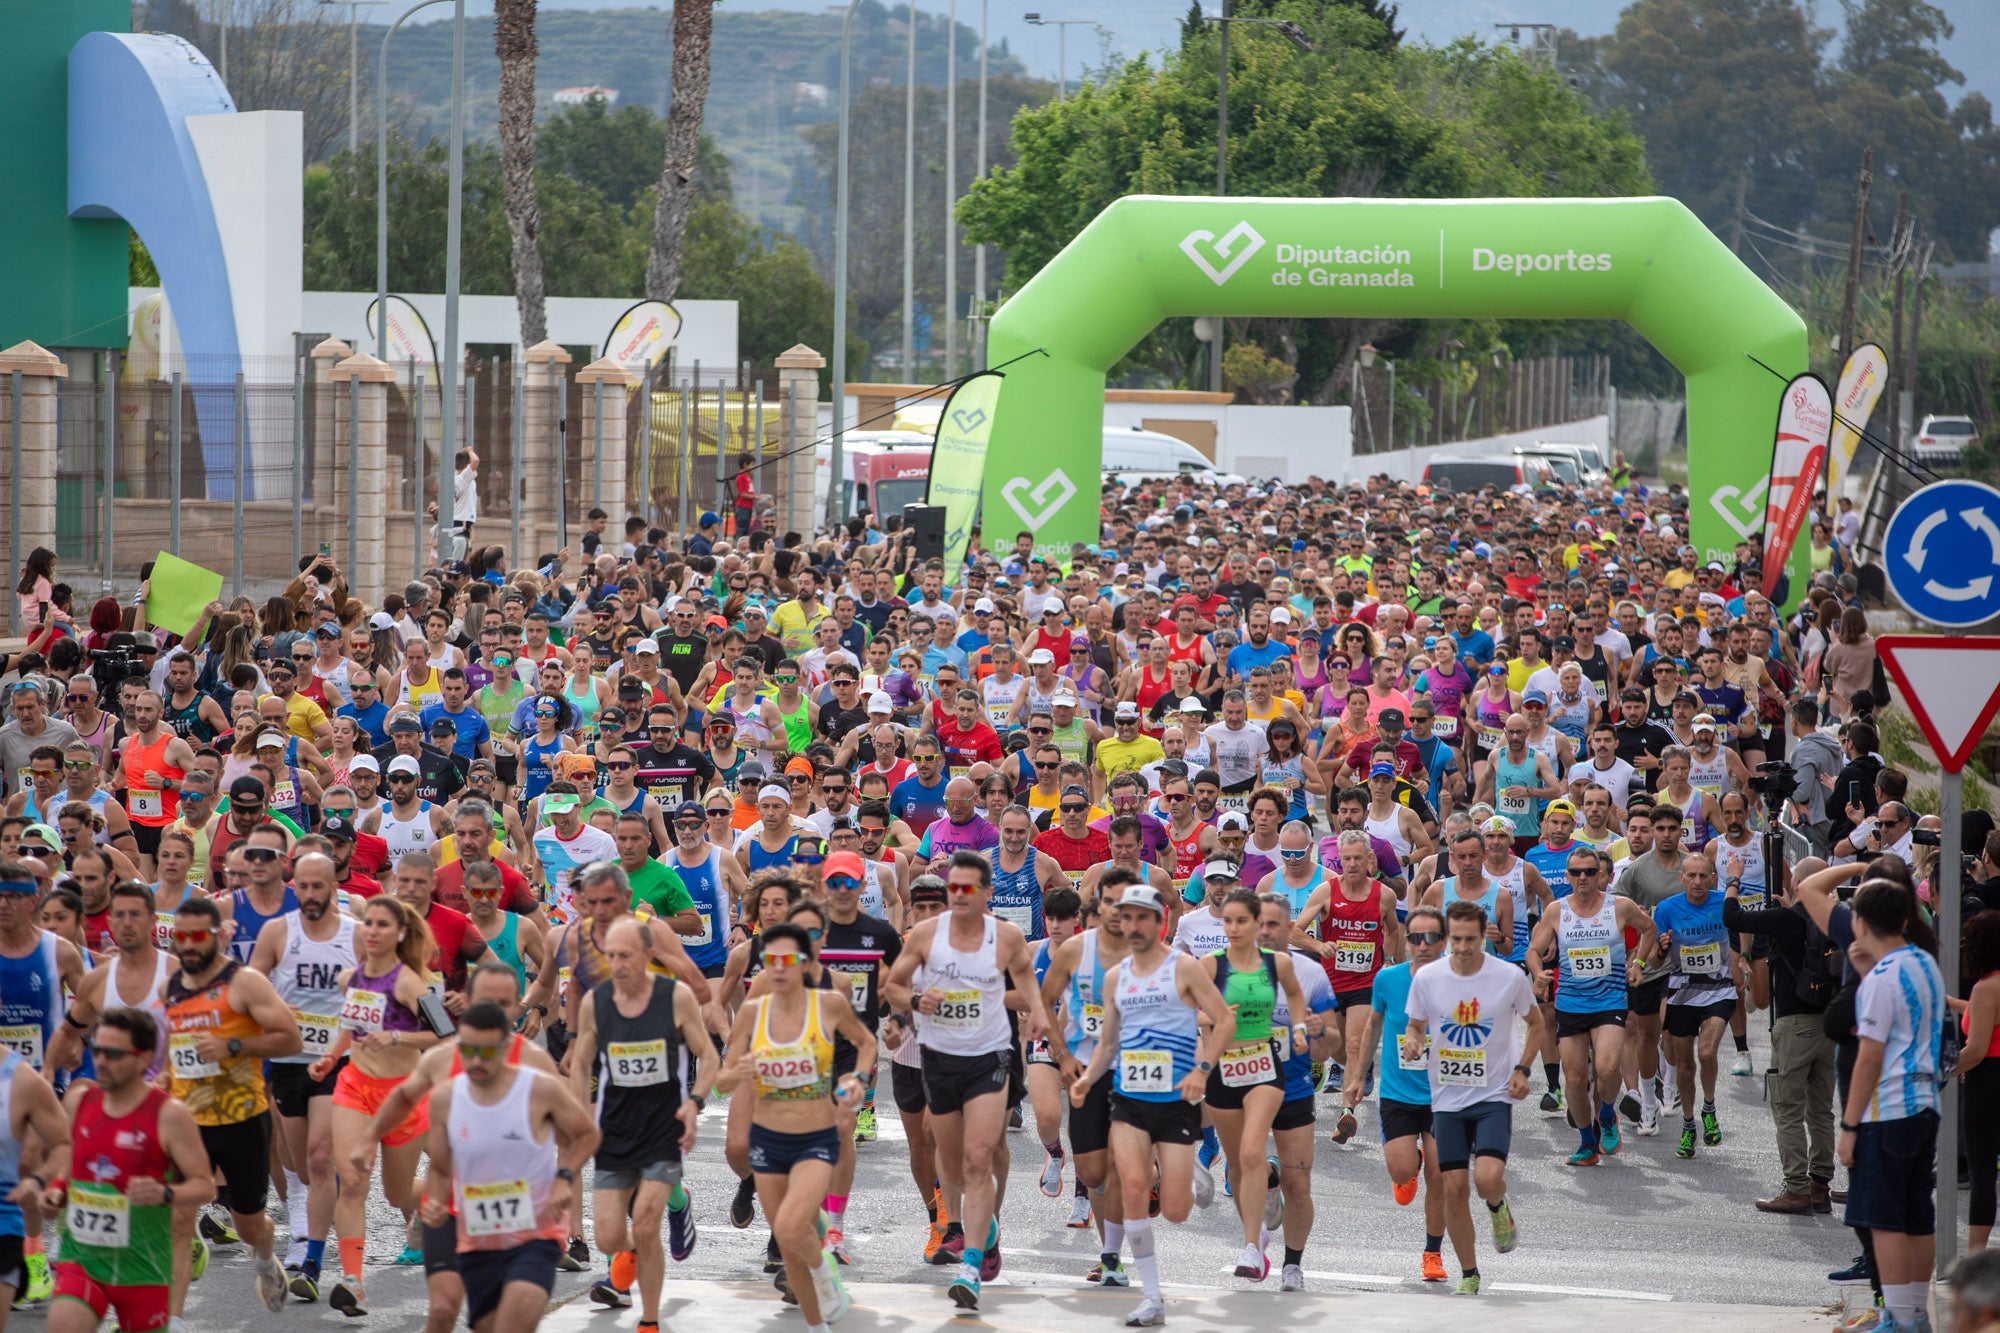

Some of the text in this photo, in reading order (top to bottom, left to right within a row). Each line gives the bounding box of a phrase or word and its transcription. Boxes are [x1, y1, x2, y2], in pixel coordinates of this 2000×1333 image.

[1275, 243, 1411, 268] Diputación
[1471, 248, 1613, 276] Deportes
[1271, 268, 1415, 288] de Granada
[934, 483, 981, 498] Deportes
[139, 799, 147, 810] 8
[269, 790, 295, 803] 032
[1503, 797, 1525, 808] 300
[991, 894, 1031, 905] LMUÑÉCAR
[1566, 929, 1611, 939] MARACENA
[1337, 950, 1373, 964] 3194
[1575, 957, 1605, 971] 533
[1686, 954, 1714, 967] 851
[1121, 994, 1168, 1007] MARACENA
[342, 1003, 381, 1024] 2236
[297, 1025, 330, 1044] 28
[618, 1057, 659, 1076] 832
[758, 1060, 814, 1078] 2026
[1128, 1065, 1164, 1081] 214
[1222, 1056, 1272, 1078] 2008
[1440, 1060, 1484, 1077] 3245
[475, 1198, 520, 1221] 117
[73, 1209, 118, 1234] 872
